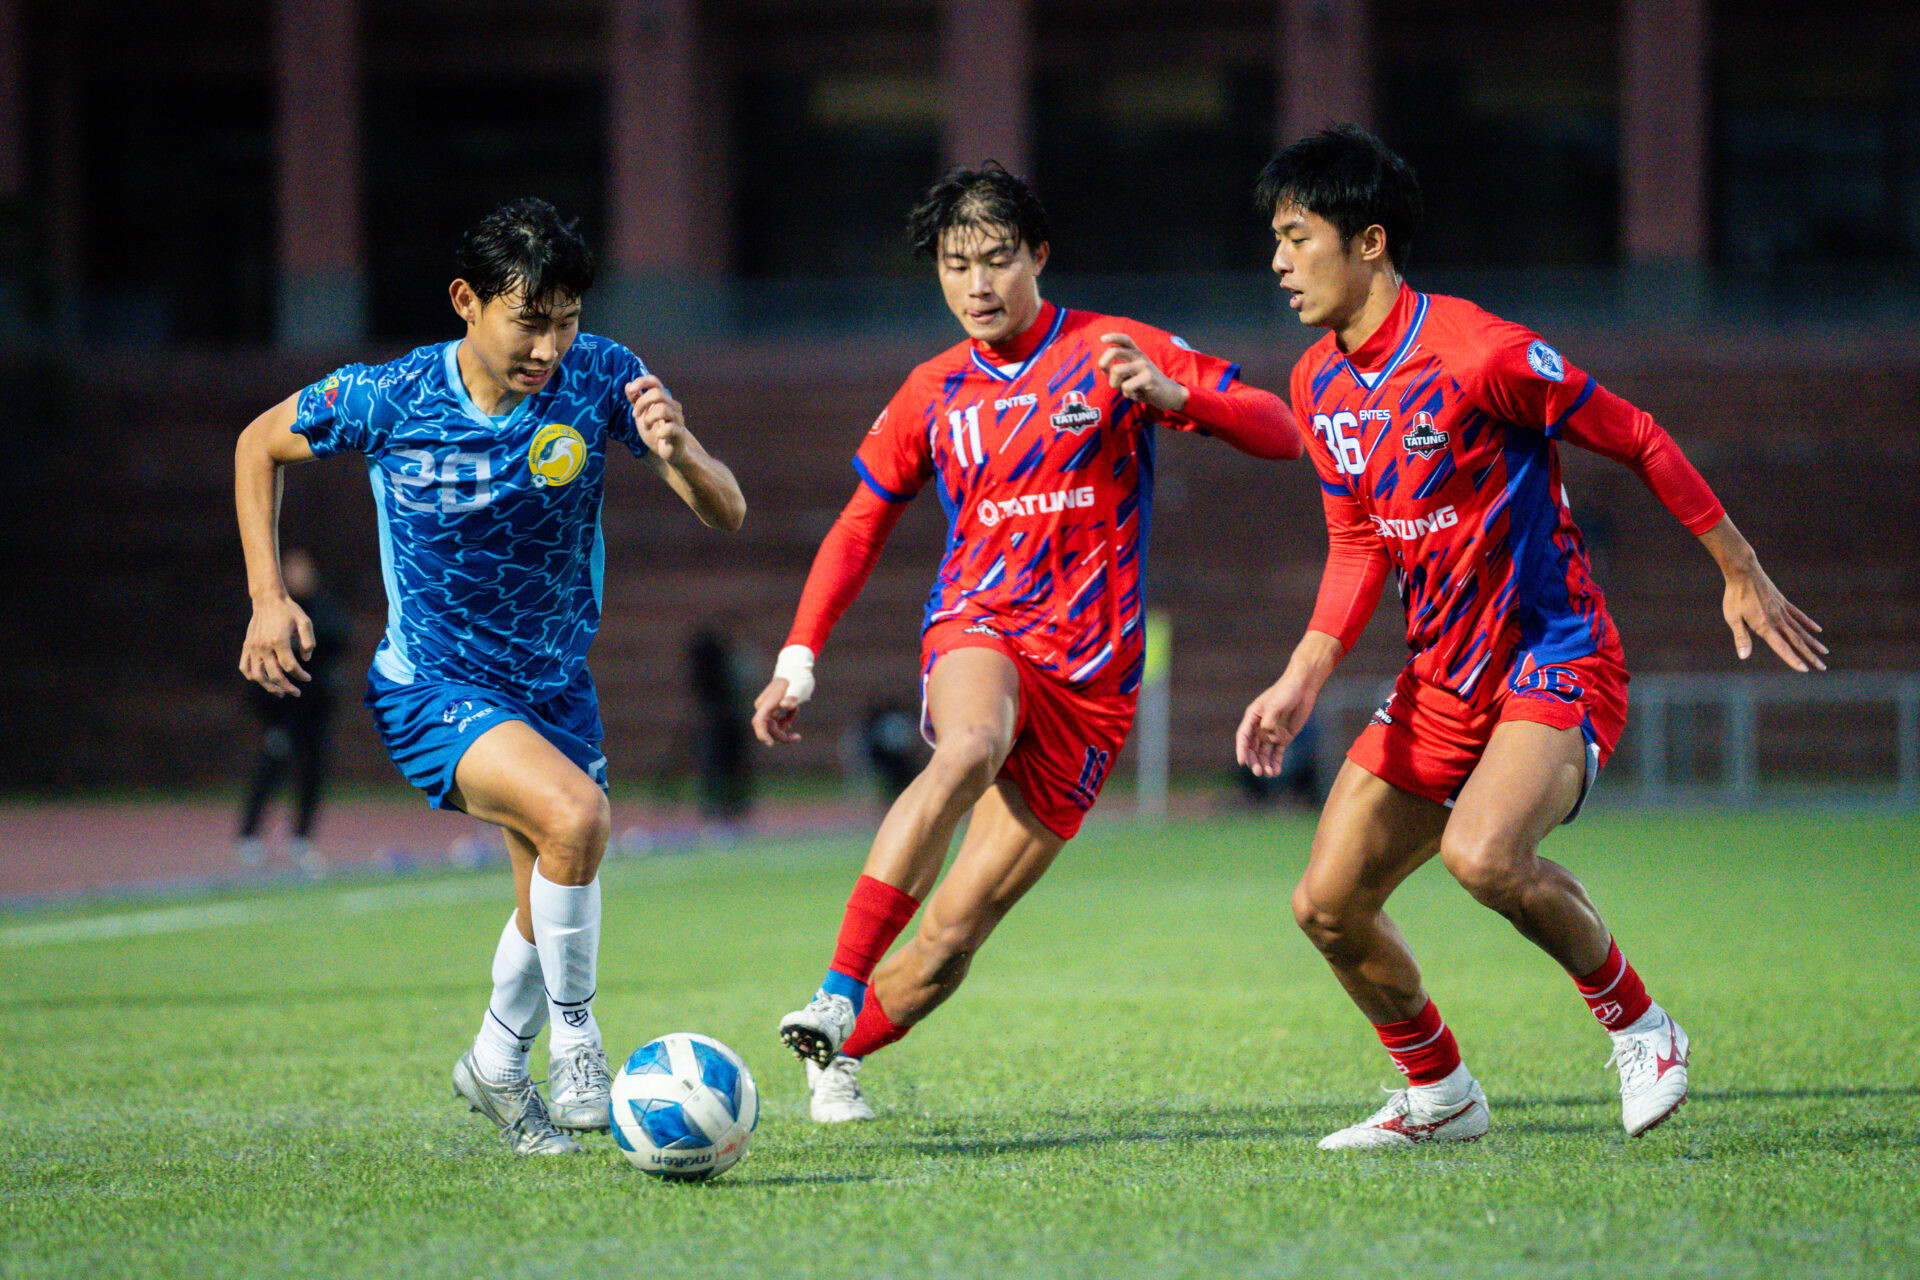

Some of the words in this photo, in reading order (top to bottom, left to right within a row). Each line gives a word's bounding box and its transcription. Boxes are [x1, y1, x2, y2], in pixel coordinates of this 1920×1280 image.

[994, 393, 1038, 411] ENTES
[1053, 409, 1098, 426] TATUNG
[1359, 409, 1391, 421] ENTES
[949, 405, 984, 468] 11
[1313, 411, 1366, 475] 36
[1404, 433, 1447, 447] TATUNG
[390, 448, 492, 514] 20
[997, 486, 1095, 519] TATUNG
[1379, 505, 1459, 541] ATUNG
